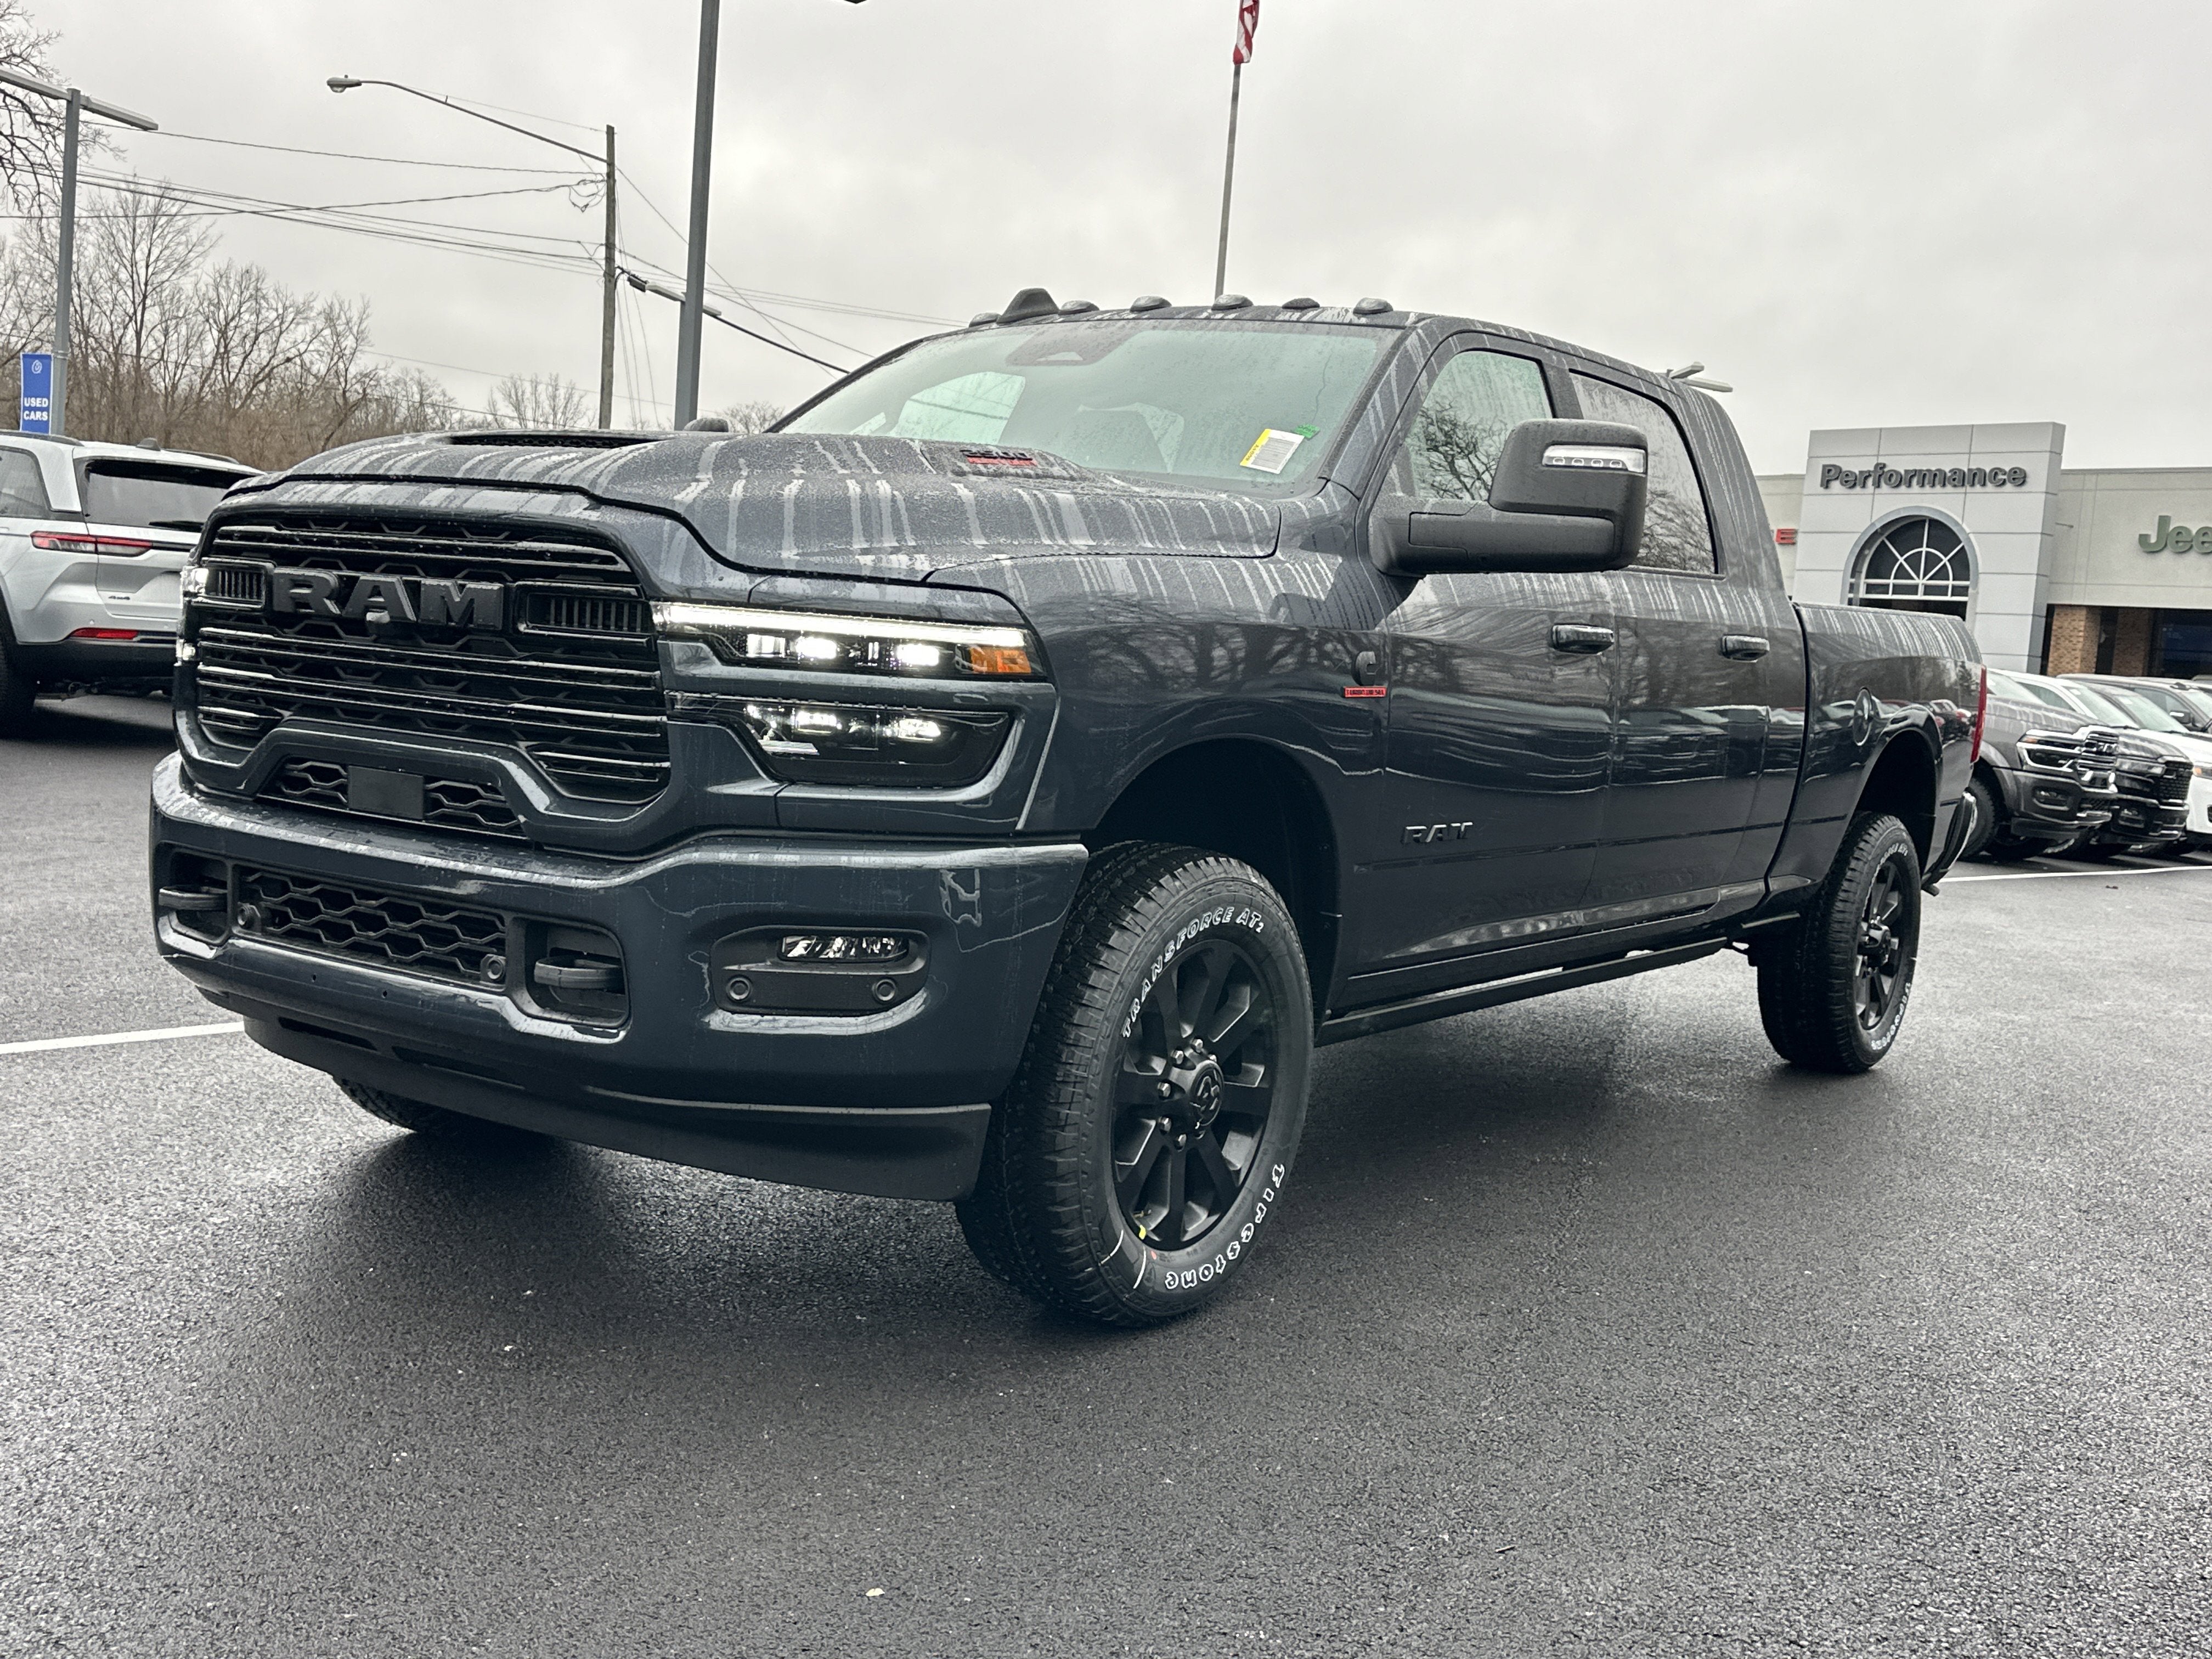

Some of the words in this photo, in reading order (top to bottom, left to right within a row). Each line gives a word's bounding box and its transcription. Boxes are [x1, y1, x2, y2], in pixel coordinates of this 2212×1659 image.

[23, 410, 48, 421] CARS
[24, 397, 49, 407] USED
[1819, 462, 2028, 489] Performance
[274, 567, 504, 630] RAM
[1120, 907, 1235, 1038] TRANSFORCE
